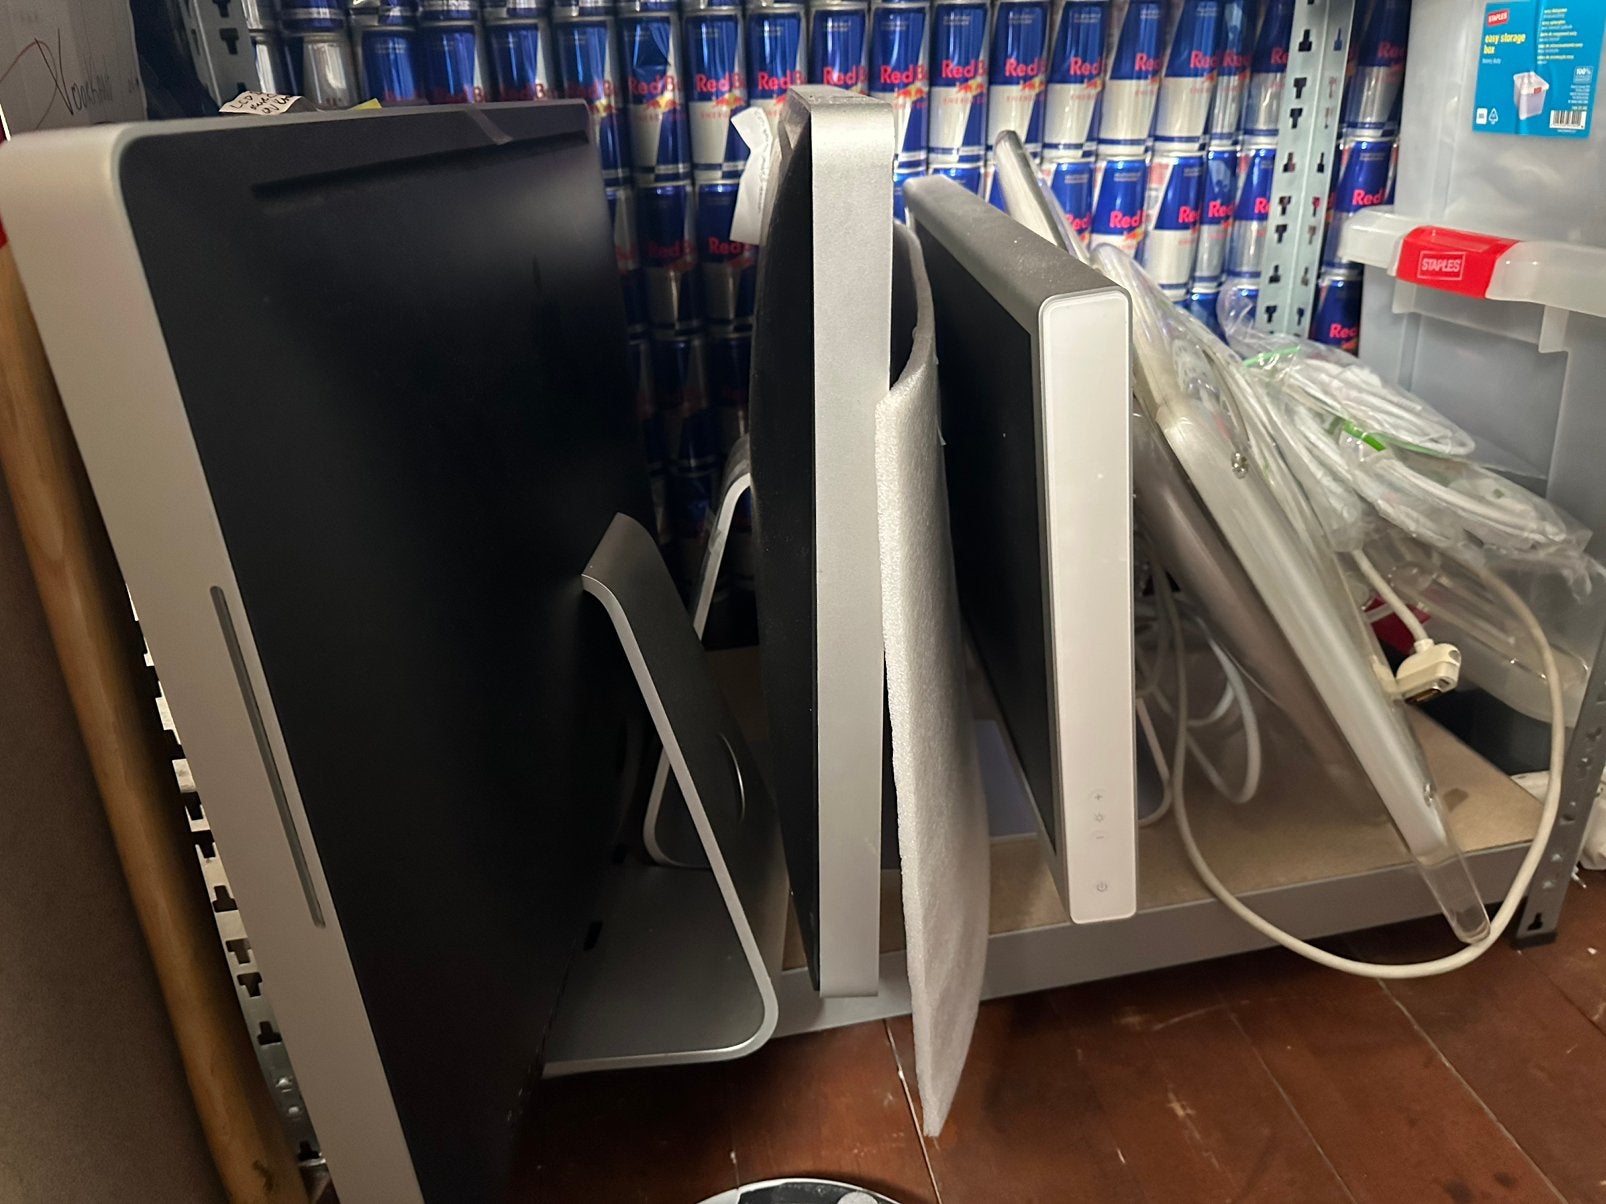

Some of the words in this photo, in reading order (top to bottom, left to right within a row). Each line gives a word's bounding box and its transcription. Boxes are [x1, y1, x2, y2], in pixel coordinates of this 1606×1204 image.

[1488, 12, 1508, 24] STAPLES
[1485, 34, 1499, 45] easy
[1501, 33, 1526, 44] storage
[1483, 45, 1495, 54] box
[880, 64, 914, 84] Red
[942, 59, 975, 78] Red
[1005, 56, 1039, 77] Red
[1070, 56, 1101, 75] Red
[630, 74, 661, 95] Red
[695, 71, 730, 92] Red
[758, 69, 791, 90] Red
[823, 65, 857, 86] Red
[1352, 188, 1383, 206] Red
[1109, 211, 1141, 229] Red
[709, 236, 741, 255] Red
[1421, 258, 1461, 273] STAPLES
